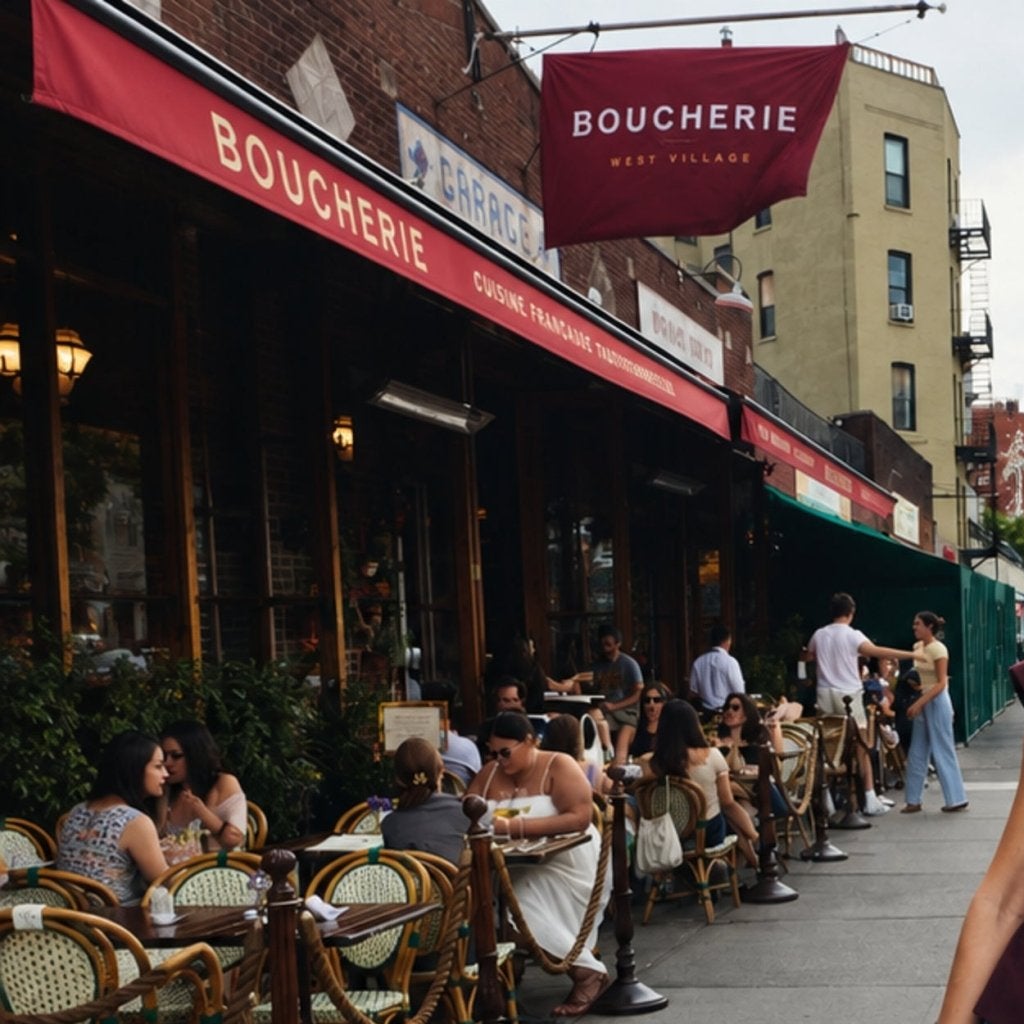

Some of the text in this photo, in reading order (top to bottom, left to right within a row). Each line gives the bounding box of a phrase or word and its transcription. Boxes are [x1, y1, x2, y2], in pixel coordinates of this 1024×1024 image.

[572, 104, 797, 137] BOUCHERIE
[610, 152, 750, 167] WEST VILLAGE
[211, 110, 428, 273] BOUCHERIE
[472, 270, 528, 318] CUISINE
